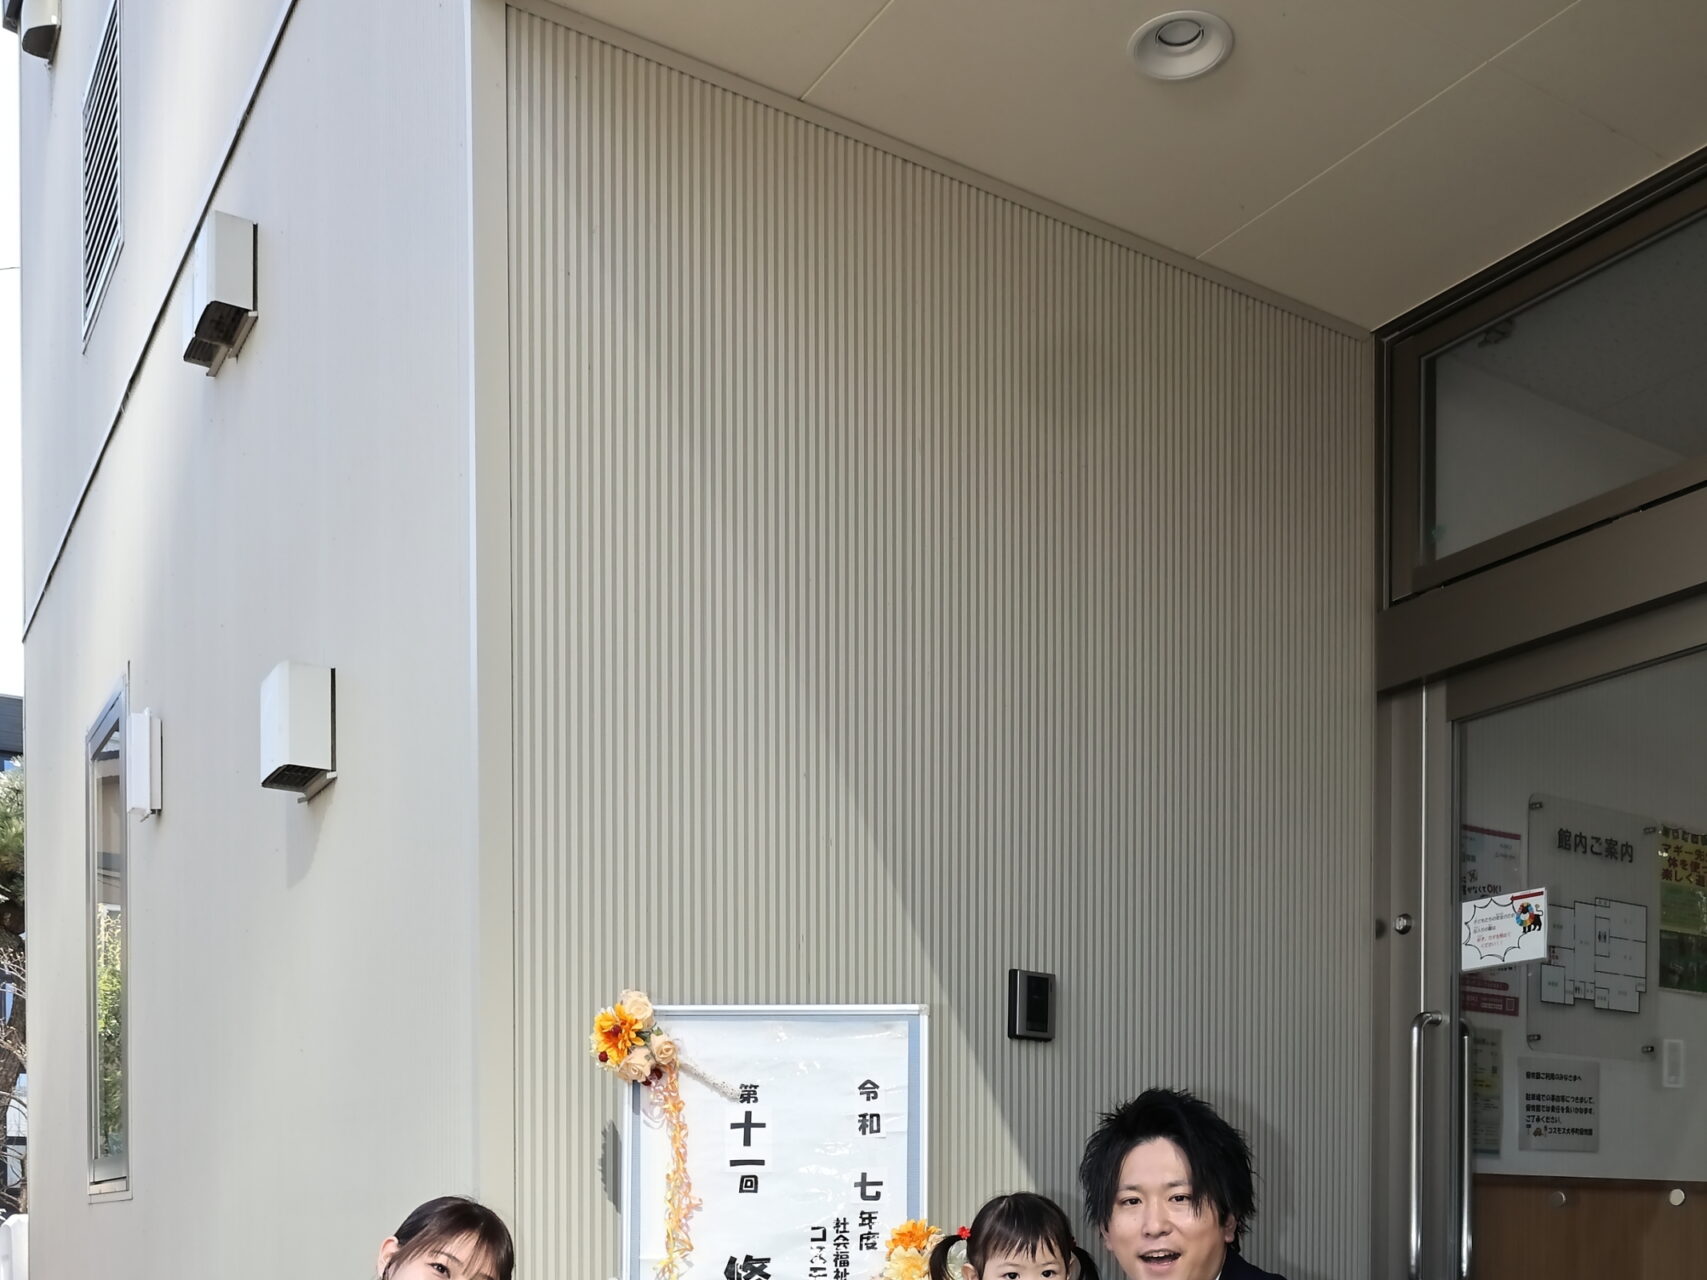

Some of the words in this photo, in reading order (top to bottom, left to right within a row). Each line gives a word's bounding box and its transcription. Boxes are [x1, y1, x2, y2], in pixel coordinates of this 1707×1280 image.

[1557, 828, 1635, 864] 館内ご案内
[729, 1083, 767, 1195] 第十一回
[853, 1078, 884, 1252] 令和七年度
